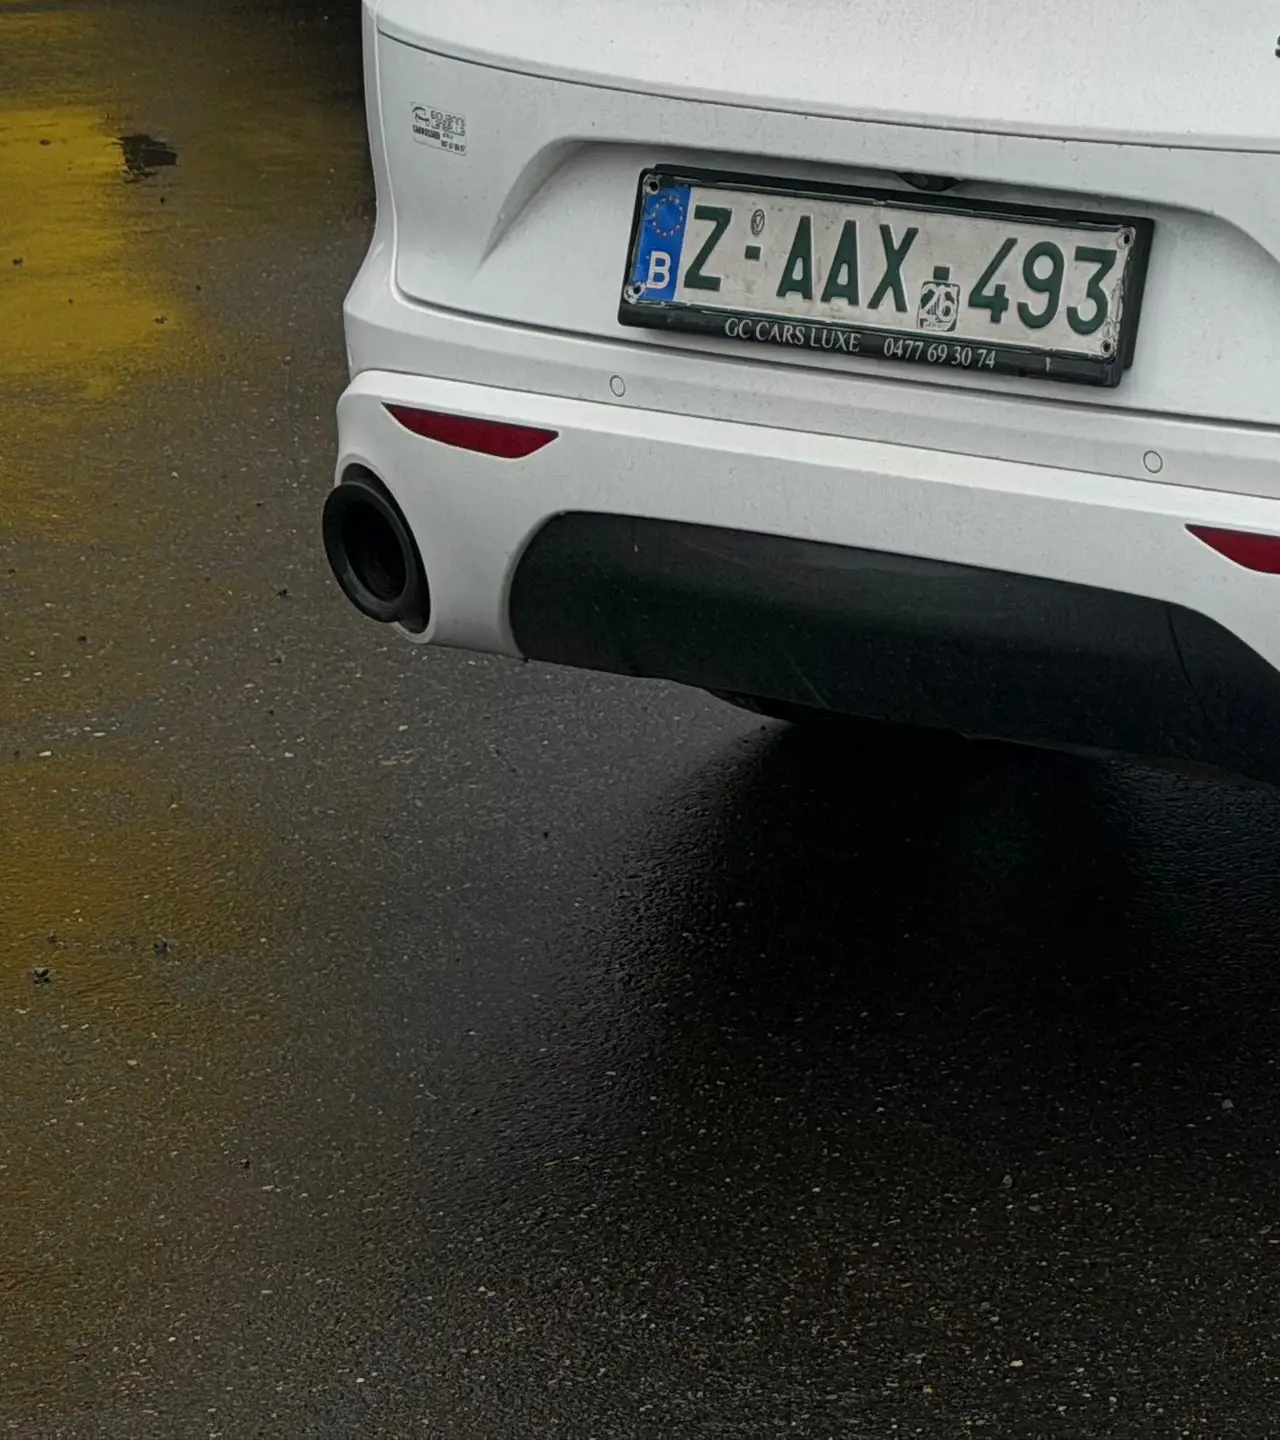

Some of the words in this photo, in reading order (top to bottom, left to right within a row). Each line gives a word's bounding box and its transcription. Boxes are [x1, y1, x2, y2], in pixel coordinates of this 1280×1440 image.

[646, 250, 672, 289] B
[724, 317, 752, 340] GC
[755, 318, 805, 346] CARS
[809, 329, 861, 354] LUXE
[883, 336, 924, 360] 0477
[926, 343, 948, 364] 69
[951, 345, 972, 367] 30
[977, 348, 997, 369] 74
